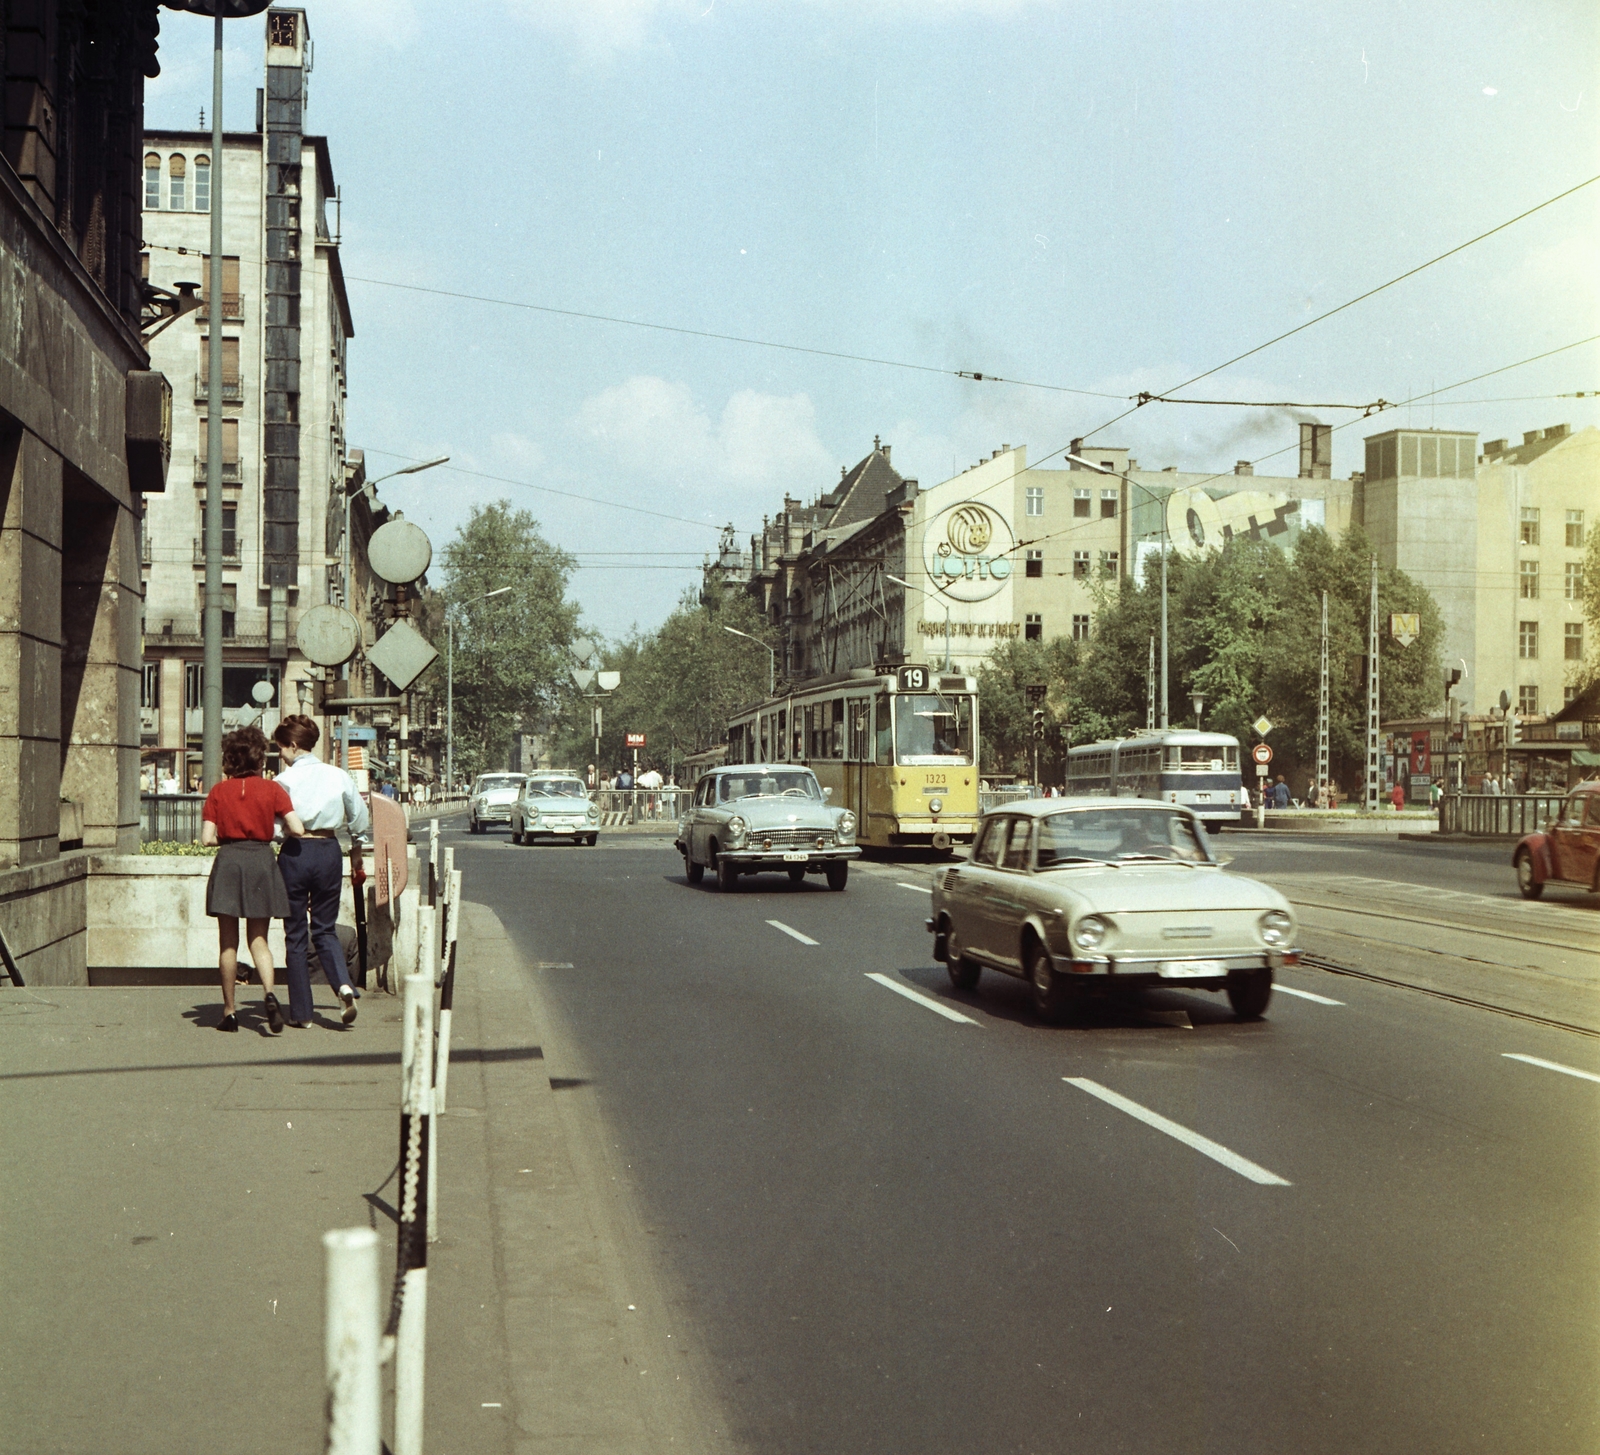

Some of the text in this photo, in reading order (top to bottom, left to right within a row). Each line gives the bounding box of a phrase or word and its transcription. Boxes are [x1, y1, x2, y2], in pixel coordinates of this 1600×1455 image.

[933, 553, 1010, 580] LOTTO
[1393, 614, 1418, 633] M
[904, 669, 923, 688] 19
[627, 734, 644, 742] MM
[926, 774, 946, 784] 1323
